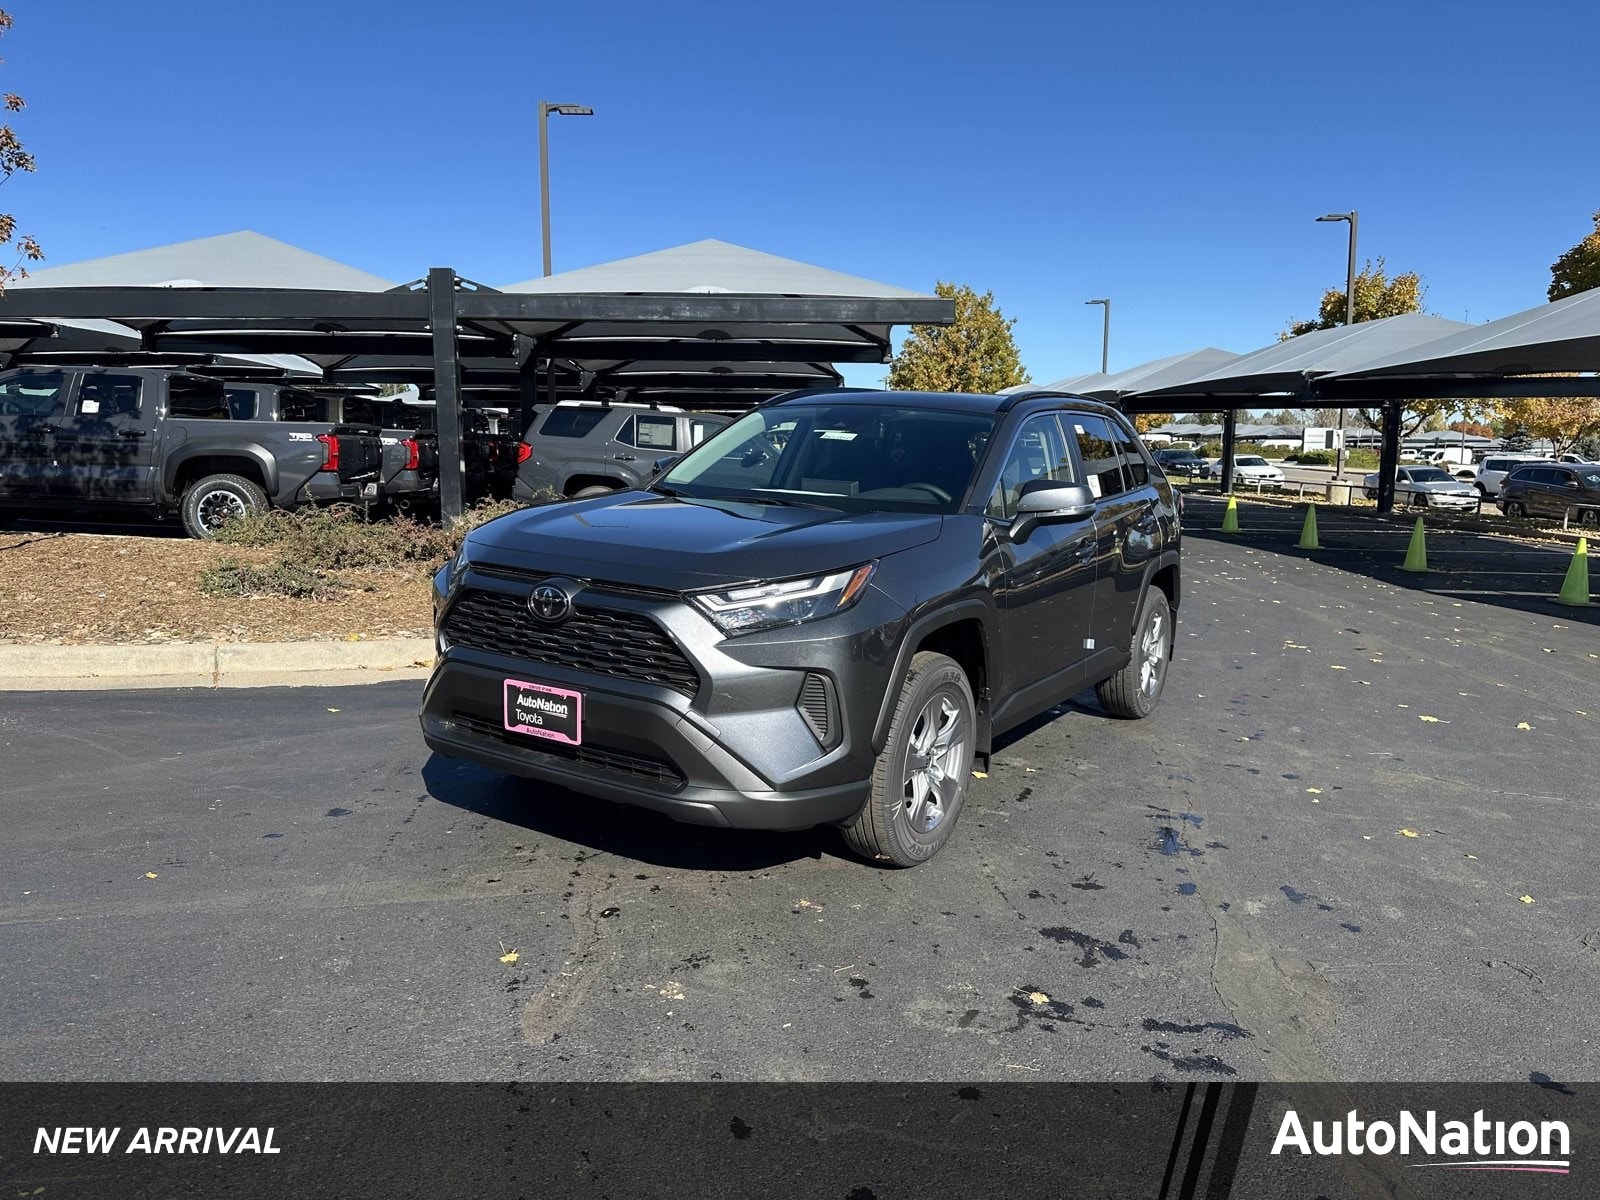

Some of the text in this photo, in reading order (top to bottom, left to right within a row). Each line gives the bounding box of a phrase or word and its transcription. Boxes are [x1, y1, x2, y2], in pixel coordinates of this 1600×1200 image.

[517, 693, 568, 714] AutoNation
[515, 708, 543, 725] Toyota
[526, 727, 555, 738] AutoNation
